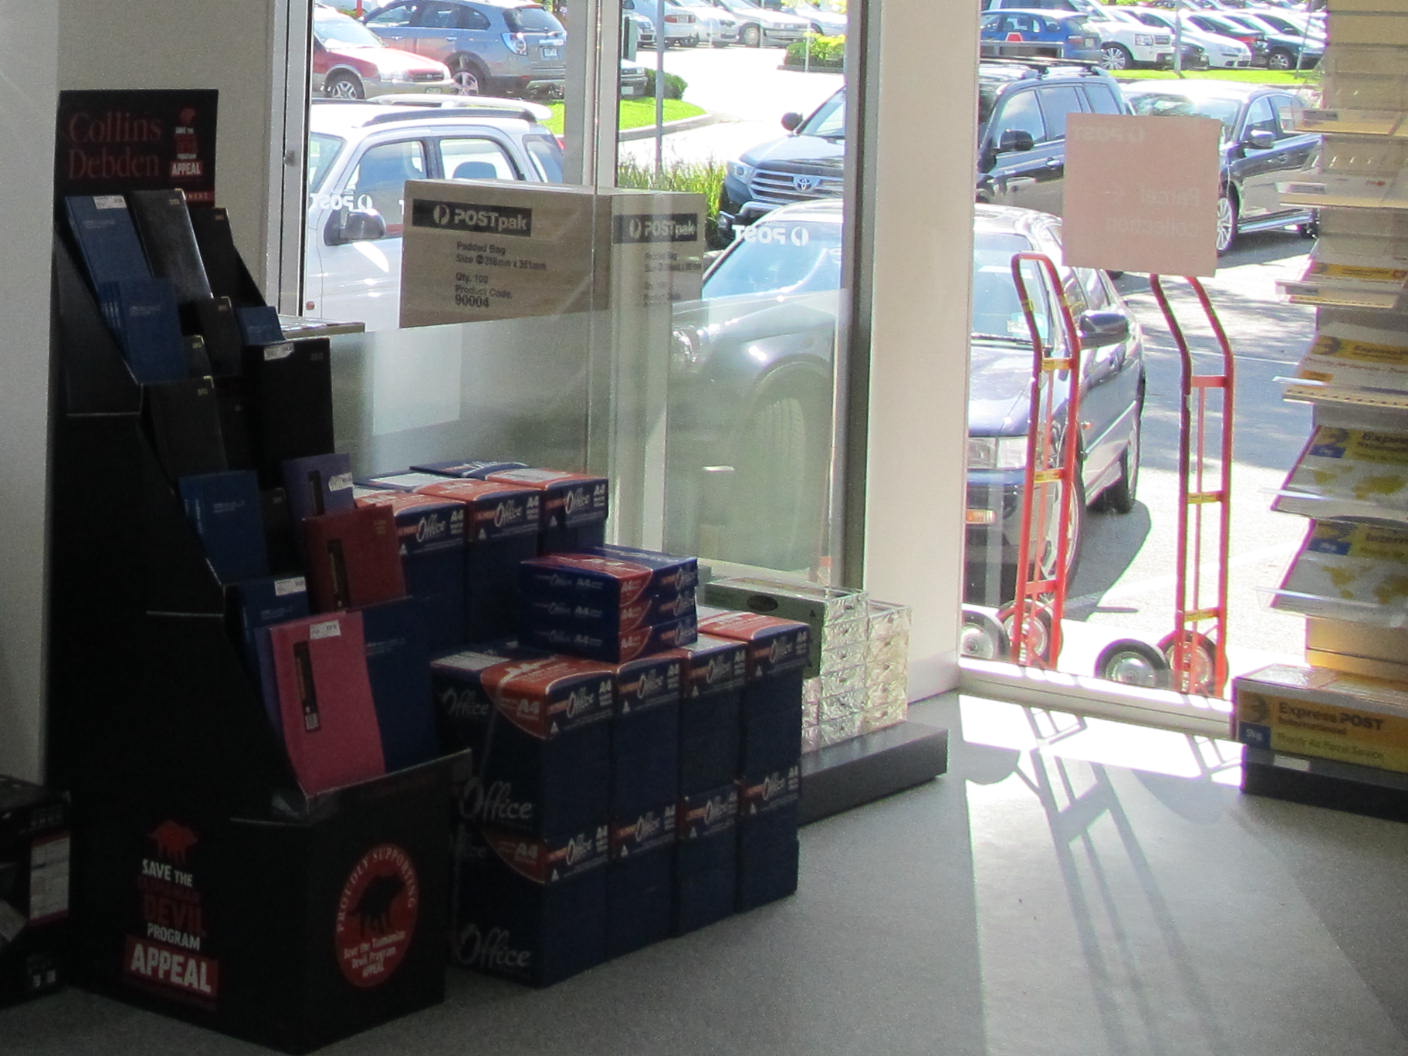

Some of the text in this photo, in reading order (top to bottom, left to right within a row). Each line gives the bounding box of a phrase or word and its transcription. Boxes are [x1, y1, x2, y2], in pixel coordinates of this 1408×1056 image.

[68, 108, 163, 143] Collins
[68, 149, 161, 180] Debden
[170, 160, 202, 177] APPEAL
[454, 208, 528, 232] POSTpak
[455, 295, 490, 309] 90004
[516, 698, 541, 721] A4
[1340, 711, 1385, 731] POST
[459, 776, 534, 821] Office
[516, 842, 539, 861] A4
[142, 858, 172, 882] SAVE
[174, 870, 194, 888] THE
[336, 847, 418, 933] PROUDLY SUPPORTING
[147, 922, 201, 952] PROGRAM
[455, 923, 533, 969] Office
[130, 943, 212, 993] APPEAL
